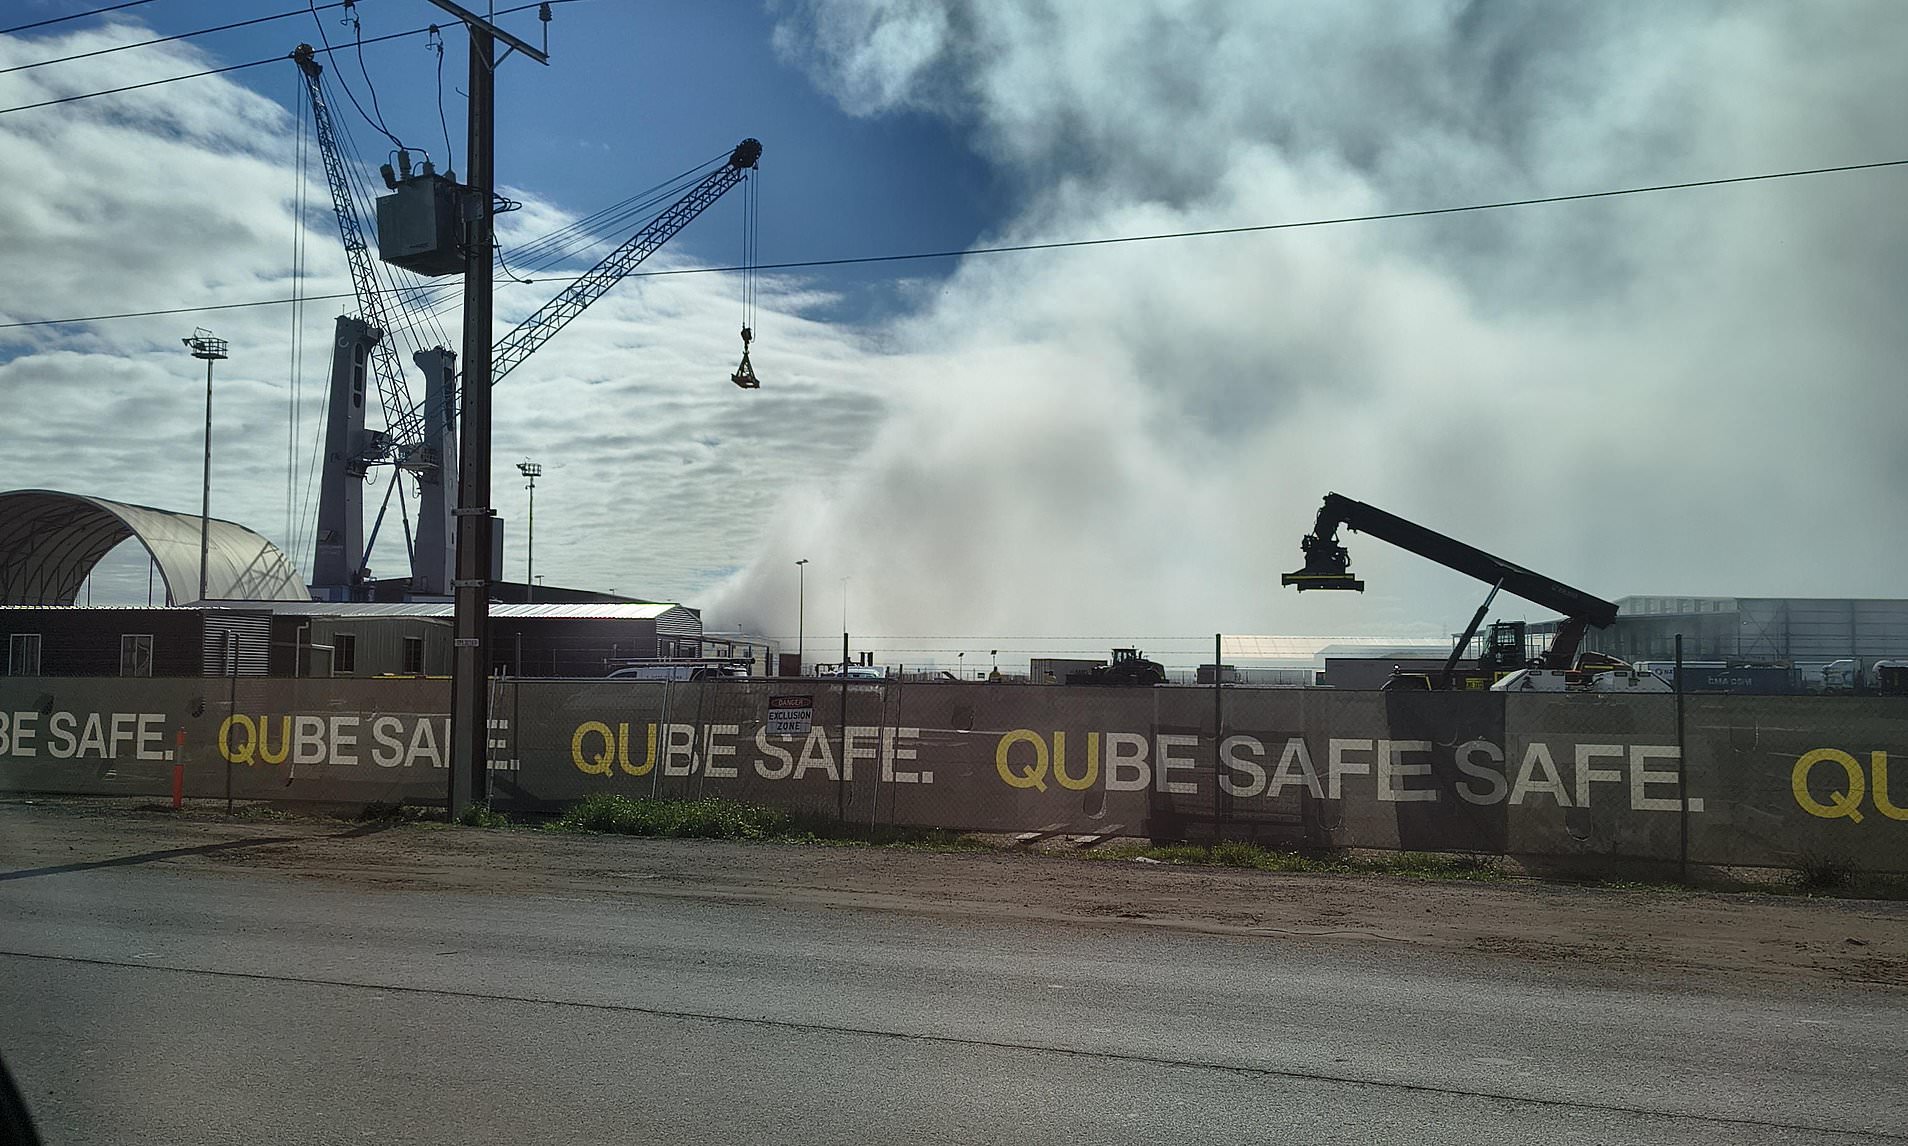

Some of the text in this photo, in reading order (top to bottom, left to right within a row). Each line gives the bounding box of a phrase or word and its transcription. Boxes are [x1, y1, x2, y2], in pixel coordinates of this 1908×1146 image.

[48, 711, 174, 761] SAFE.
[769, 711, 811, 720] EXCLUSION
[777, 722, 801, 731] ZONE
[218, 714, 520, 771] QUBE SAE.
[571, 721, 934, 784] QUBE SAFE.
[995, 729, 1705, 812] QUBE SAFE SAFE.
